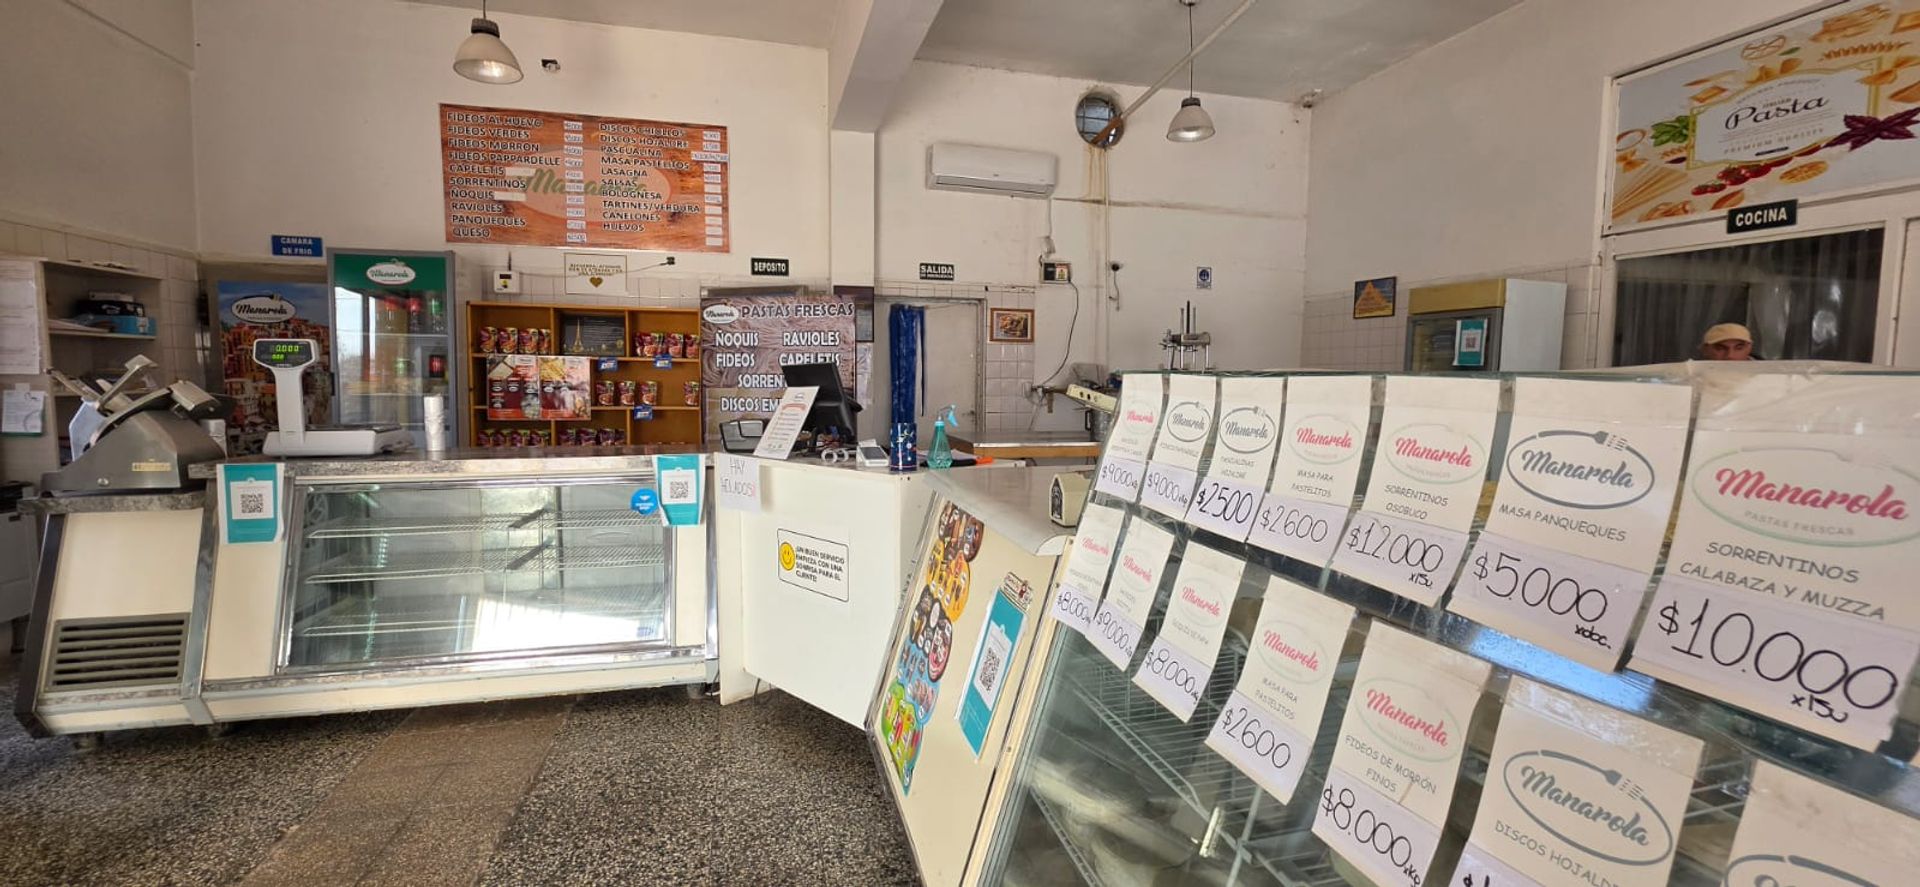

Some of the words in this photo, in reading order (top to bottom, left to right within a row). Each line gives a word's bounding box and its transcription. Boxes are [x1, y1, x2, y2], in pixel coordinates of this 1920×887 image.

[447, 112, 485, 123] FIDEOS
[504, 117, 544, 127] HUEVO
[1725, 97, 1829, 129] Pasta
[448, 125, 486, 135] FIDEOS
[489, 128, 529, 138] VERDES
[600, 123, 635, 133] DISCOS
[448, 138, 486, 148] FIDEOS
[600, 135, 636, 144] DISCOS
[448, 152, 486, 161] FIDEOS
[490, 153, 561, 166] PAPPARDELLE
[600, 146, 662, 157] PASCUALINA
[450, 165, 505, 175] CAPELETIS
[601, 157, 633, 165] MASA
[601, 169, 648, 177] LASAGNA
[450, 177, 526, 189] SORRENTINOS
[602, 178, 637, 187] SALSAS
[602, 189, 662, 200] BOLOGNESA
[452, 202, 502, 212] RAVIOLES
[602, 211, 661, 221] CANELONES
[452, 215, 526, 226] PANQUEQUES
[1736, 207, 1787, 226] COCINA
[453, 228, 490, 237] QUESO
[603, 223, 645, 232] HUEVOS
[754, 262, 786, 272] DEPOSITO
[920, 264, 953, 274] SALIDA
[741, 303, 790, 318] PASTAS
[794, 302, 855, 318] FRESCAS
[715, 329, 760, 348] ÑOQUIS
[783, 331, 841, 347] RAVIOLES
[716, 353, 755, 368] FIDEOS
[779, 352, 841, 367] CAPELETIS
[737, 374, 787, 388] SORREN
[721, 397, 760, 412] DISCOS
[762, 399, 782, 411] EM
[1172, 413, 1205, 431] Manarola
[1225, 420, 1268, 439] Manarola
[1296, 427, 1352, 449] Manarola
[1395, 437, 1472, 468] Manarola
[1297, 469, 1316, 479] MASA
[1316, 472, 1335, 482] PARA
[1522, 449, 1635, 489] Manarola
[1291, 483, 1332, 498] PASTELITOS
[1384, 483, 1449, 507] SORRENTINOS
[1715, 467, 1910, 522] Manarola
[1385, 502, 1428, 520] OSOBUCO
[1498, 503, 1532, 520] MASA
[1533, 511, 1627, 542] PANQUEQUES
[1744, 510, 1789, 529] PASTAS
[1793, 521, 1856, 537] FRESCAS
[796, 554, 817, 565] EMPIEZA
[818, 560, 829, 568] CON
[830, 563, 843, 572] UNA
[805, 548, 819, 558] BUEN
[819, 552, 845, 564] SERVICIO
[1706, 541, 1860, 583] SORRENTINOS
[796, 562, 817, 574] SONRISA
[819, 568, 834, 580] PARA
[1122, 554, 1153, 584] Manarola
[1680, 561, 1777, 595] CALABAZA
[1783, 584, 1799, 599] Y
[1801, 588, 1885, 621] MUZZA
[1181, 586, 1221, 617] Manarola
[1263, 629, 1320, 673] Manarola
[1658, 598, 1899, 710] $10.000
[1263, 678, 1282, 694] MASA
[1279, 686, 1299, 704] PARA
[1255, 690, 1296, 721] PASTELITOS
[1366, 687, 1449, 748] Manarola
[1345, 734, 1380, 761] FIDEOS
[1380, 755, 1393, 769] DE
[1394, 763, 1438, 795] MORRÓN
[1365, 767, 1397, 794] FINOS
[1520, 764, 1652, 847] Manarola
[1495, 820, 1546, 856] DISCOS
[1549, 849, 1620, 887] HOJALD
